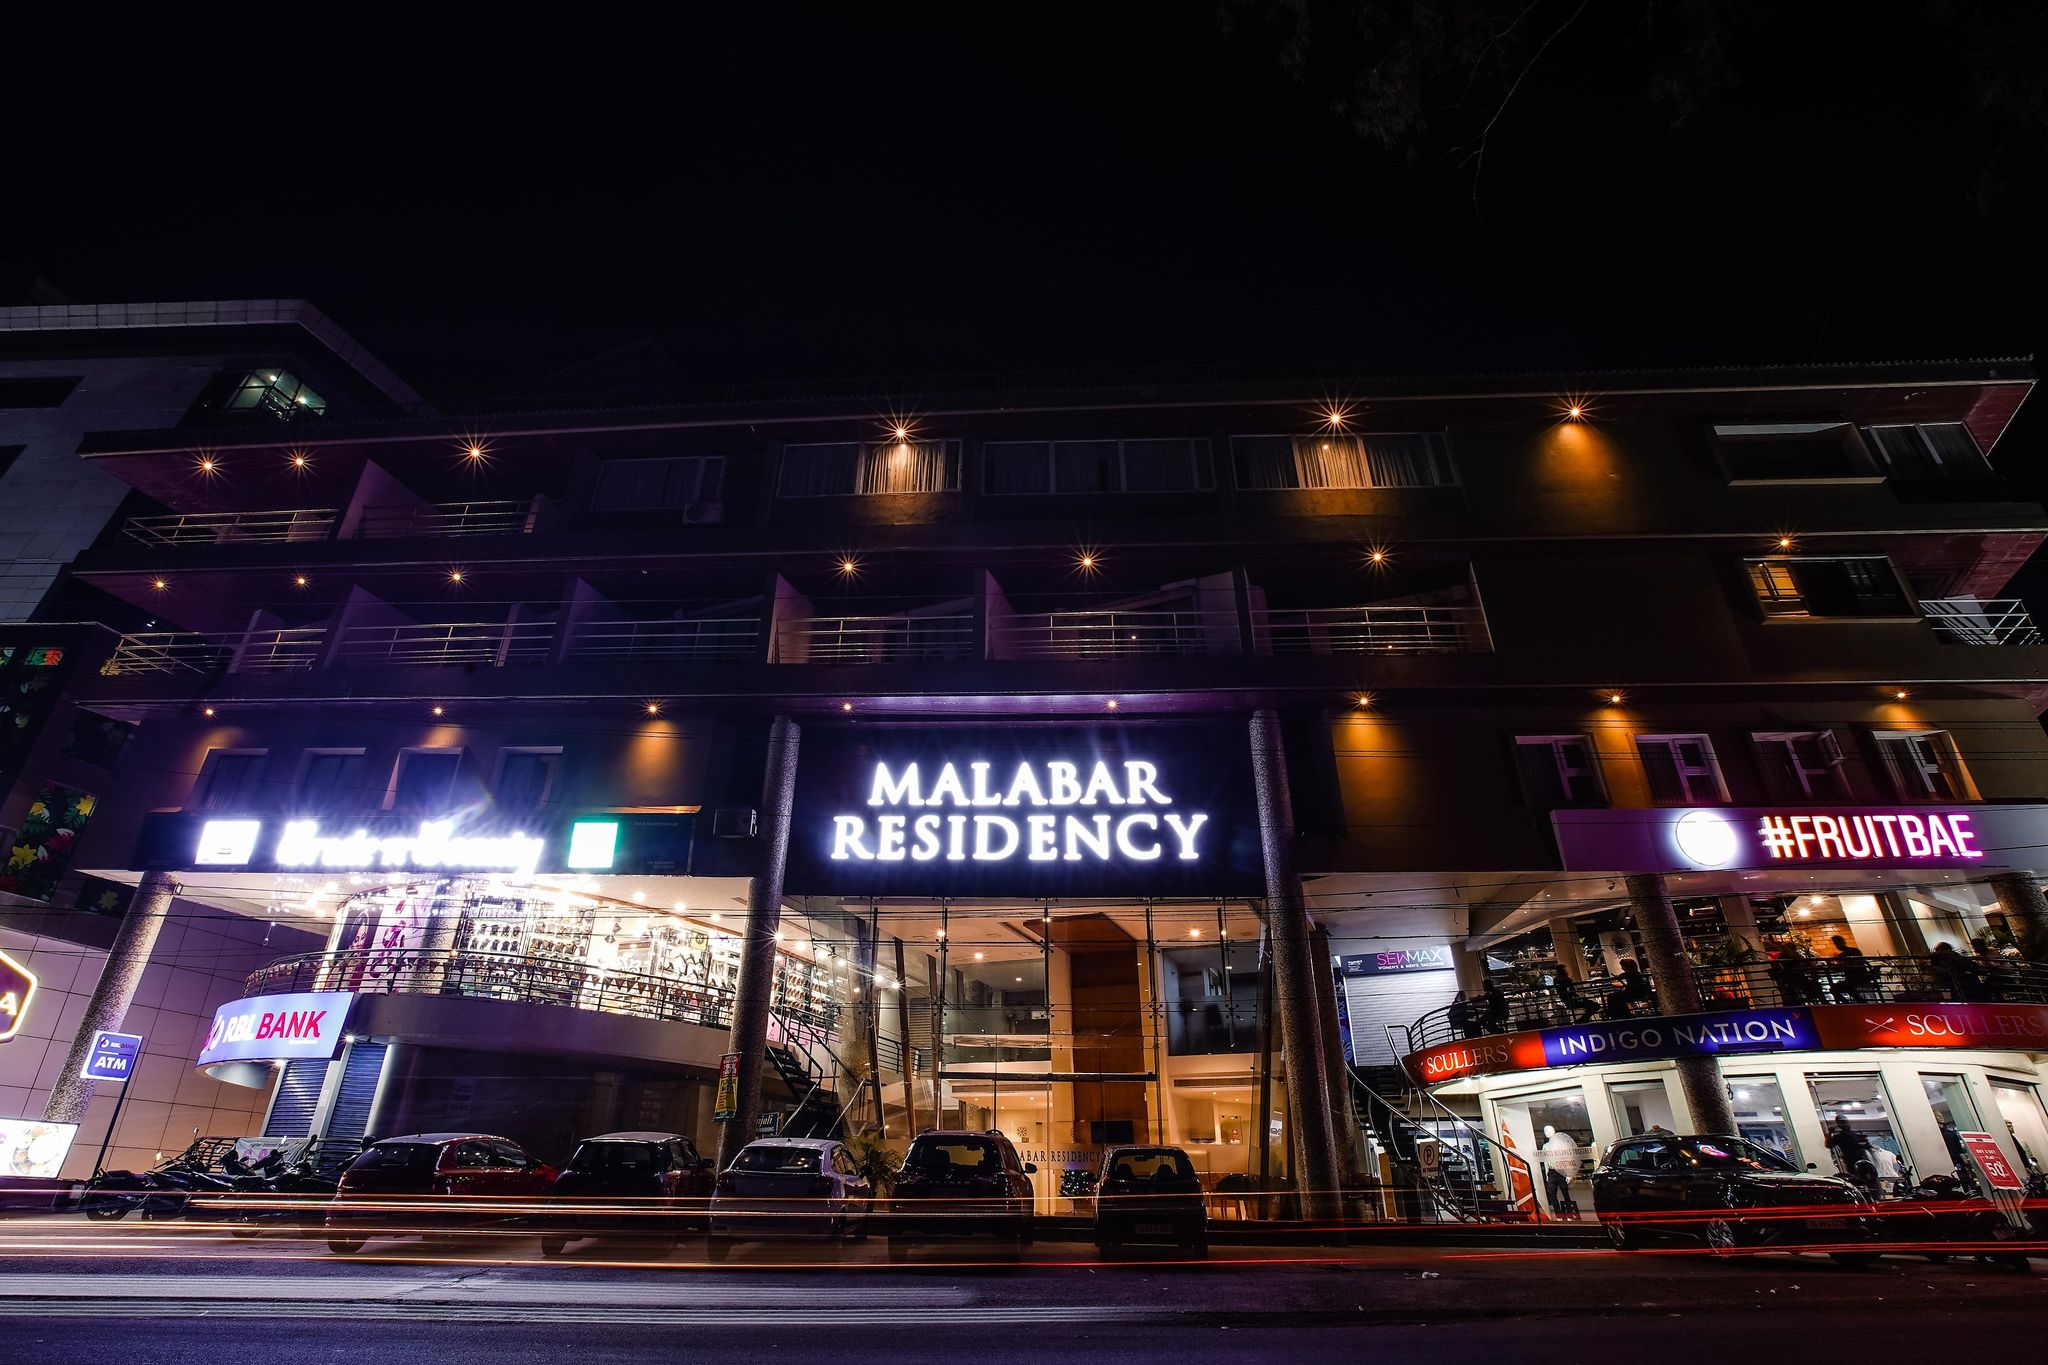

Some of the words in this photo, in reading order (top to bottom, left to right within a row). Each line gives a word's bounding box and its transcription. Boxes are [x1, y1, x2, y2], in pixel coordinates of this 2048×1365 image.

[867, 761, 1173, 806] MALABAR
[830, 813, 1209, 861] RESIDENCY
[1758, 814, 1983, 859] #FRUITBAE
[222, 1013, 257, 1043] RBL
[255, 1010, 328, 1040] BANK
[1559, 1029, 1662, 1056] INDIGO
[1673, 1019, 1796, 1046] NATION
[1906, 1014, 2047, 1037] SCULLERS
[94, 1056, 127, 1070] ATM
[1427, 1044, 1509, 1075] SCULLERS
[1020, 1150, 1047, 1162] ABAR
[1051, 1150, 1101, 1162] RESIDENCY
